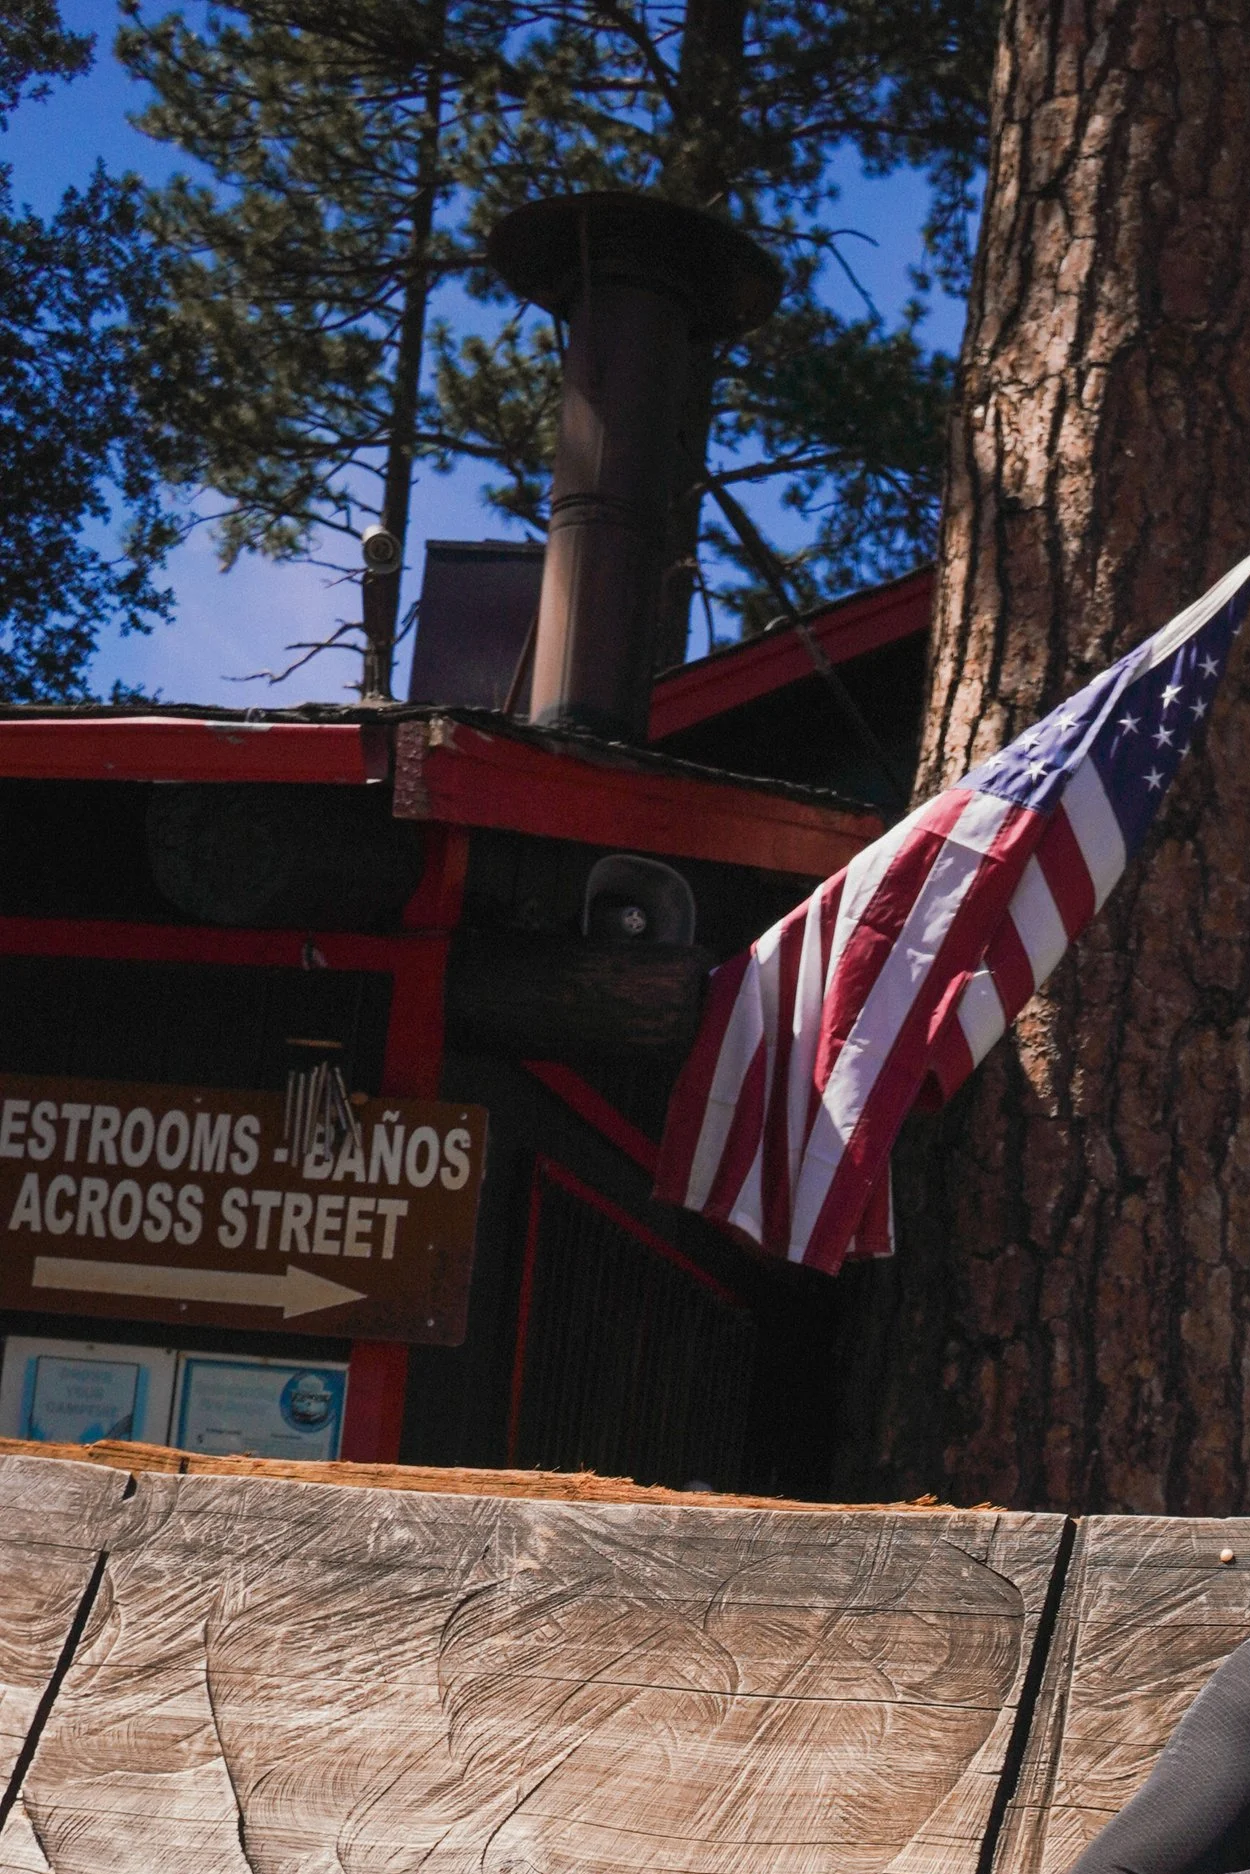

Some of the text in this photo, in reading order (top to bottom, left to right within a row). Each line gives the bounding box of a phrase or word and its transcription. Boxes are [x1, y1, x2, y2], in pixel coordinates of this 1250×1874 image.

[302, 1110, 471, 1191] BAÑOS
[9, 1172, 409, 1260] ACROSS STREET
